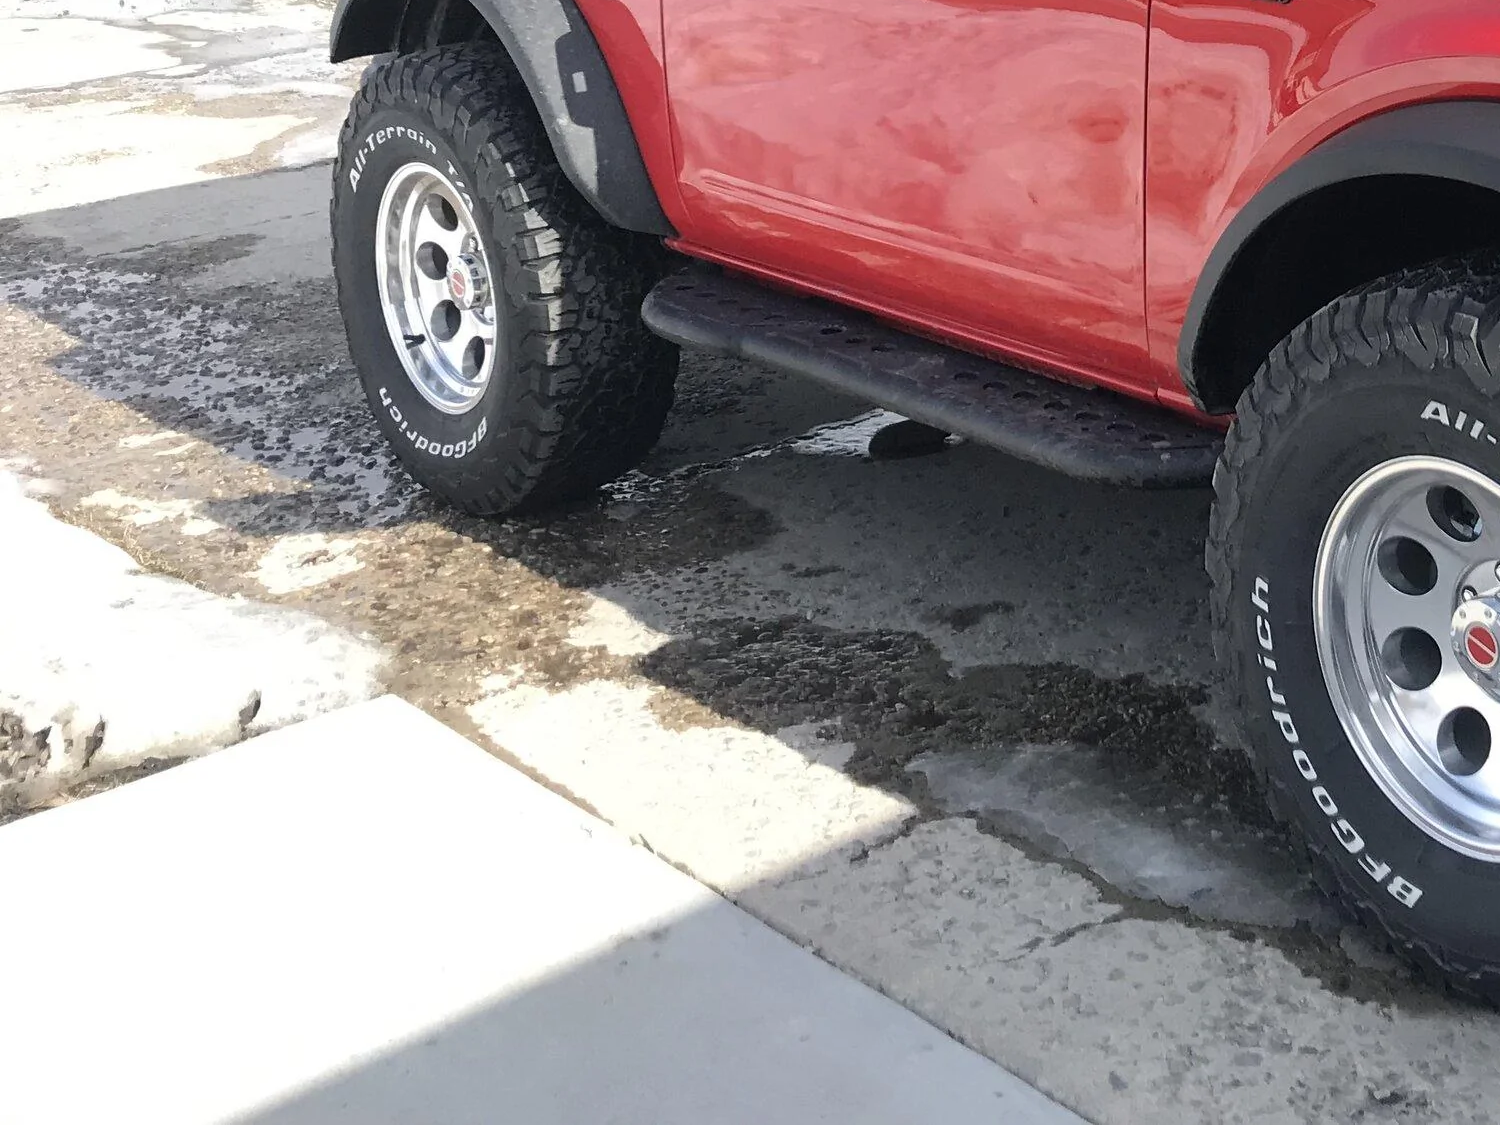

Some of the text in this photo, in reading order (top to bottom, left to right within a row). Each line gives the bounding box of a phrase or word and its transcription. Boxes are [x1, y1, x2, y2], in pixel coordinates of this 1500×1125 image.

[349, 126, 437, 193] All-Terrain
[379, 387, 487, 459] BFGoodrich
[1250, 576, 1423, 910] BFGoodrich
